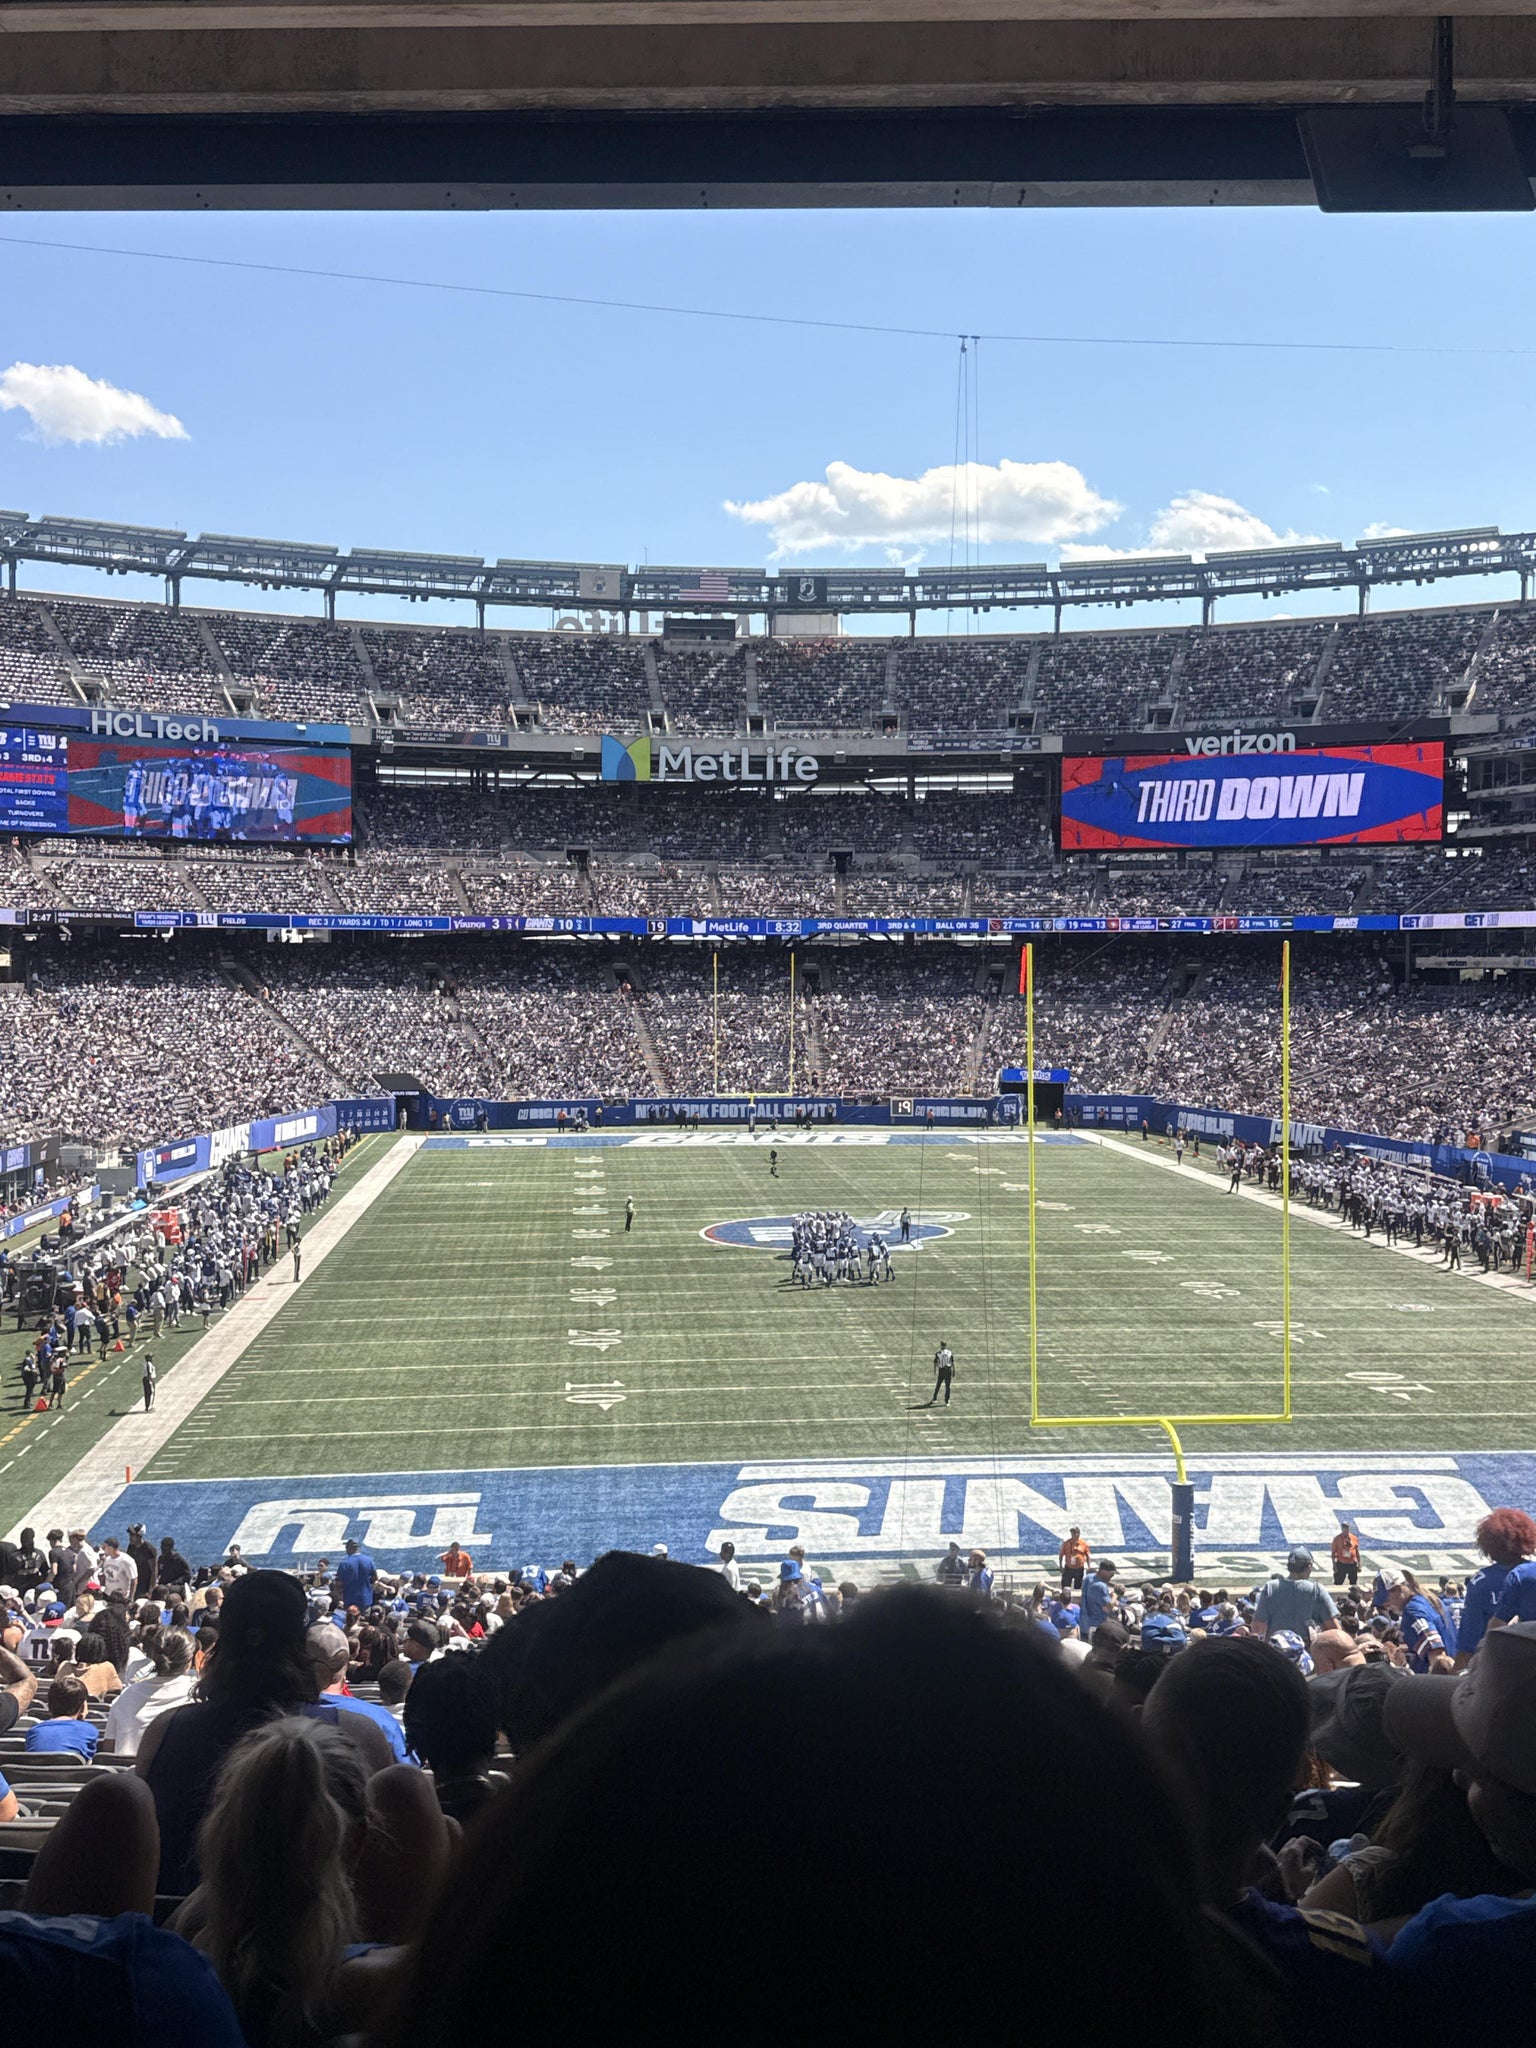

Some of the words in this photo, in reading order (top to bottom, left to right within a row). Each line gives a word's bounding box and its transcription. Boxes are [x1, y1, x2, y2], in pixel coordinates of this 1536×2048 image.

[92, 711, 219, 742] HCLTech
[1185, 729, 1296, 756] verizon
[657, 745, 819, 782] MetLife
[1137, 779, 1216, 823] THIRD
[1216, 773, 1365, 820] DOWN
[32, 913, 52, 923] 2:47
[222, 917, 247, 925] FIELDS
[308, 918, 322, 926] REC
[338, 918, 361, 927] YARDS
[362, 918, 371, 927] 34
[380, 919, 390, 927] TD
[404, 919, 423, 928] LONG
[425, 919, 433, 928] 15
[524, 918, 554, 929] GIANTS
[1239, 919, 1250, 928] 24
[1268, 919, 1279, 928] 16
[1402, 916, 1421, 928] GET
[1464, 914, 1485, 926] GET
[492, 919, 500, 929] 3
[558, 919, 573, 930] 10
[650, 921, 665, 932] 19
[709, 922, 750, 933] MetLife
[775, 922, 800, 933] 8:32
[817, 922, 832, 930] 3RD
[833, 922, 869, 930] QUARTER
[887, 922, 902, 930] 3RD
[935, 922, 954, 930] BALL
[956, 922, 967, 930] ON
[1002, 920, 1013, 929] 27
[1030, 920, 1040, 929] 14
[1068, 920, 1078, 929] 19
[1095, 920, 1106, 929] 13
[1171, 920, 1182, 929] 27
[711, 1103, 781, 1118] FOOTALL
[898, 1101, 911, 1113] 19
[529, 1108, 553, 1120] BIG
[569, 1287, 618, 1303] 30
[567, 1328, 623, 1347] 20
[1345, 1371, 1435, 1400] 10
[565, 1380, 627, 1405] 10
[704, 1474, 1500, 1558] GIANTS
[521, 1565, 540, 1579] 13
